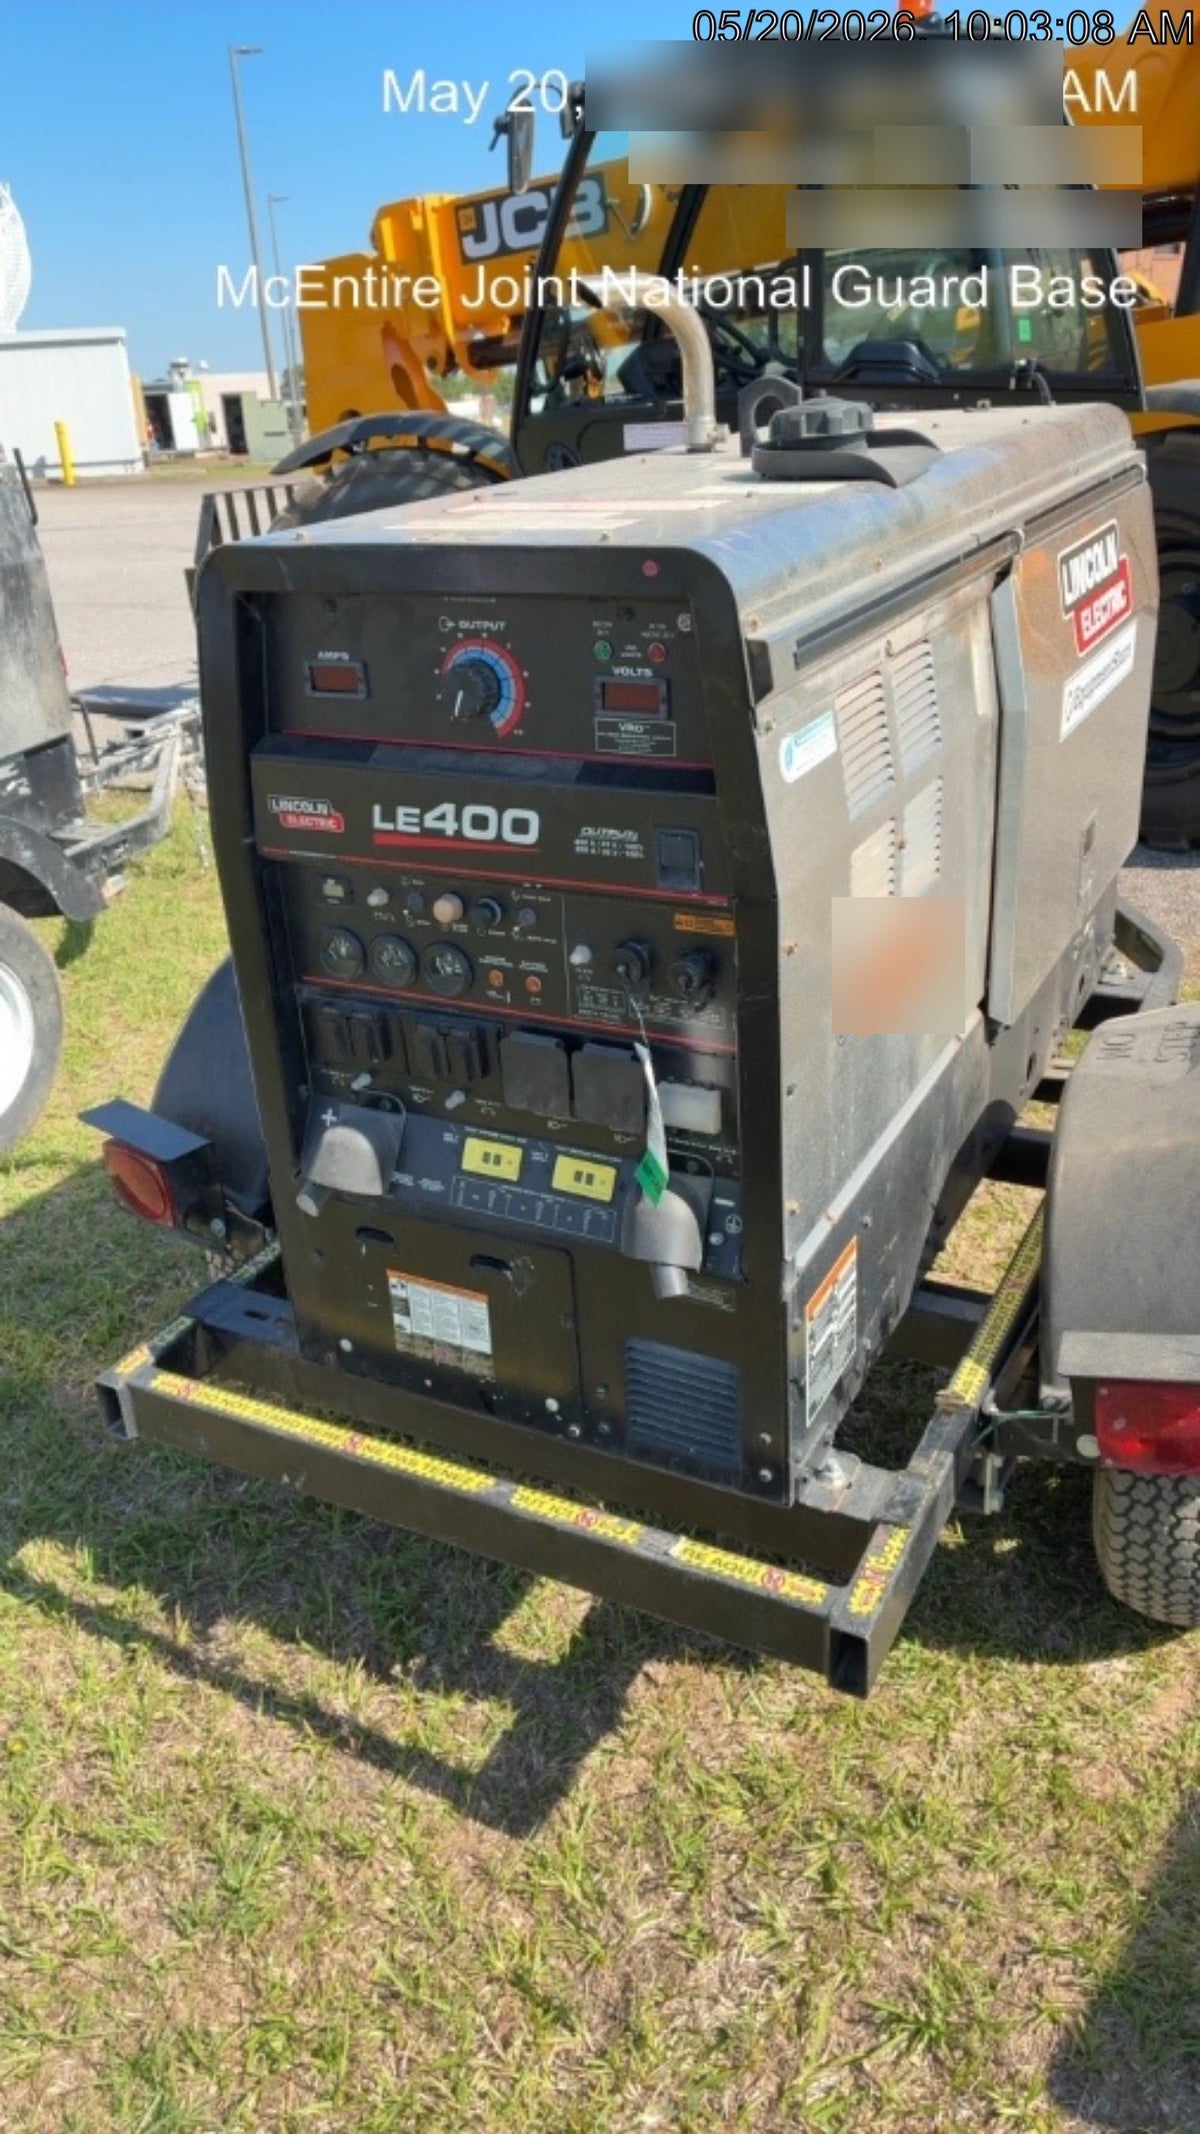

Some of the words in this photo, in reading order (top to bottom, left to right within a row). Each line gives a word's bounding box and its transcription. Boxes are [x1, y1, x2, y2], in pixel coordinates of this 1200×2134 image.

[611, 665, 653, 678] VOLTS
[271, 798, 330, 815] LINCOLN
[286, 813, 338, 828] ELECTRIC
[372, 802, 541, 846] LE400
